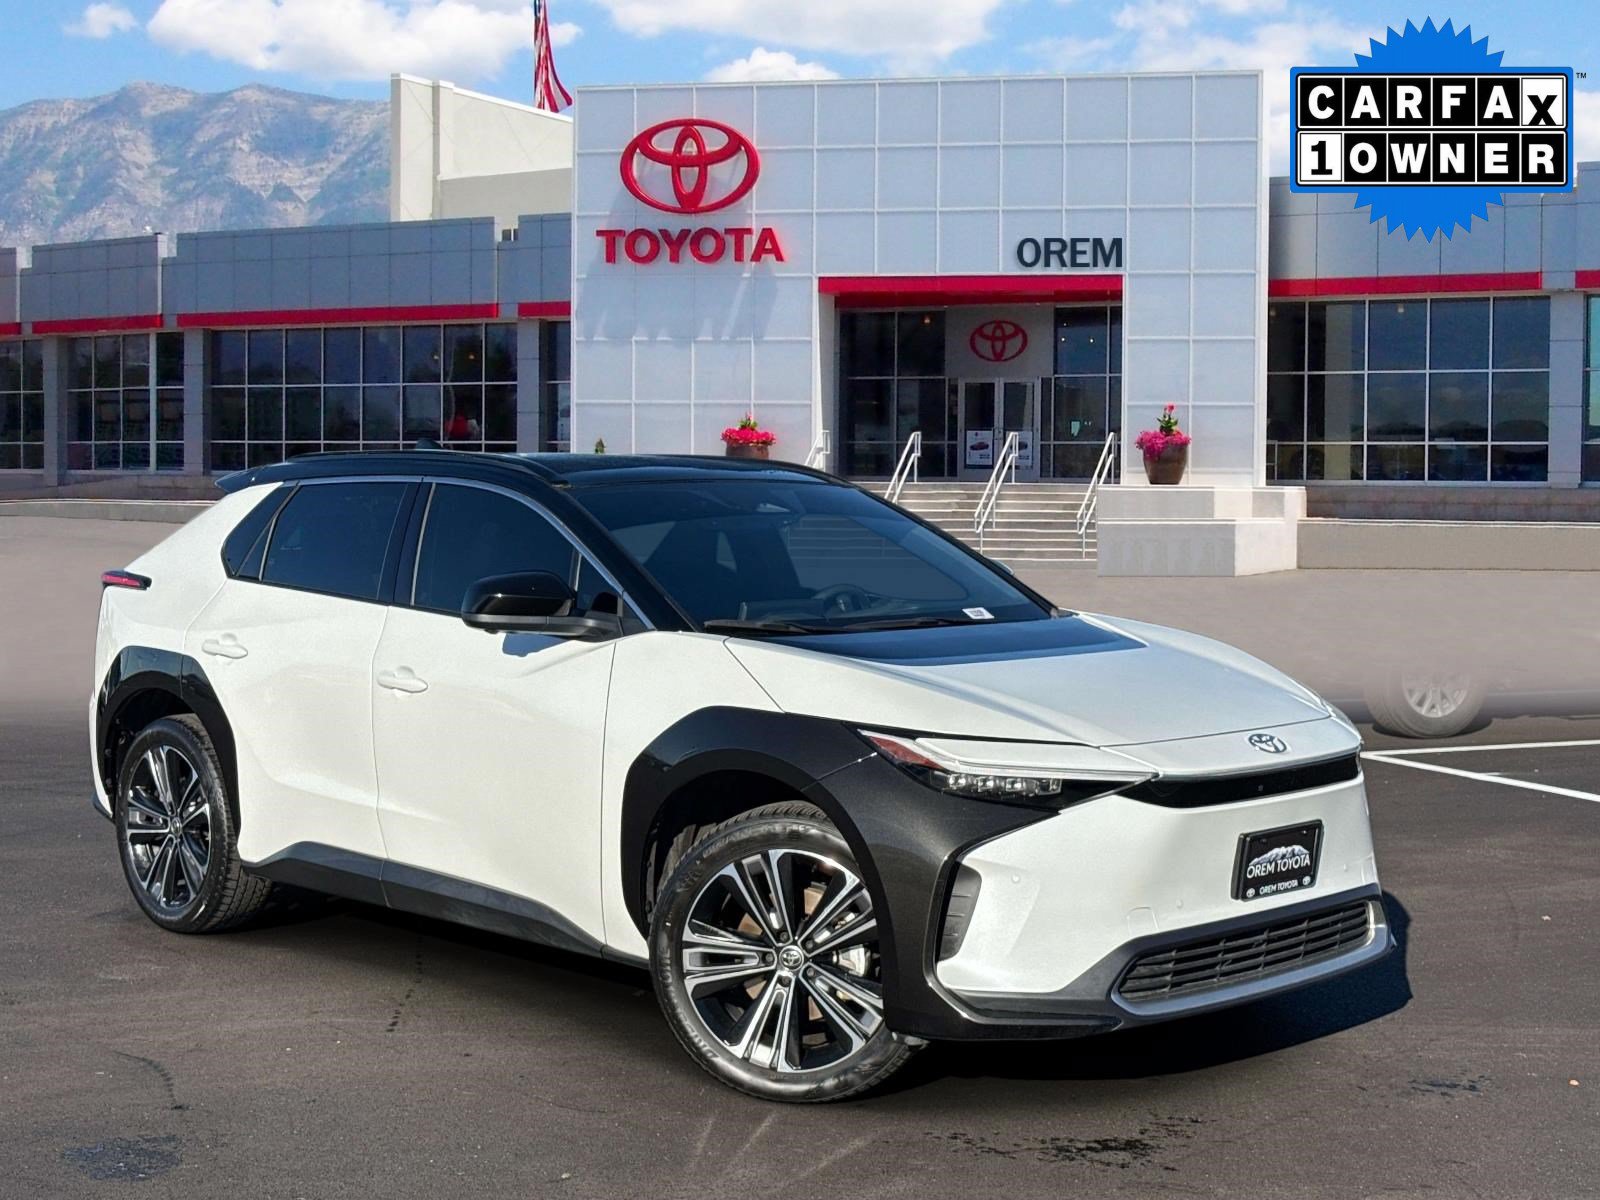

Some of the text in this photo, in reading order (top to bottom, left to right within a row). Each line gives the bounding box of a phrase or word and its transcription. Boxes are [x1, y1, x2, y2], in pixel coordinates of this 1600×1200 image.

[596, 227, 785, 264] TOYOTA
[1016, 237, 1123, 268] OREM
[1246, 854, 1311, 879] OREM TOYOTA
[1259, 879, 1299, 895] OREM TOYOTA
